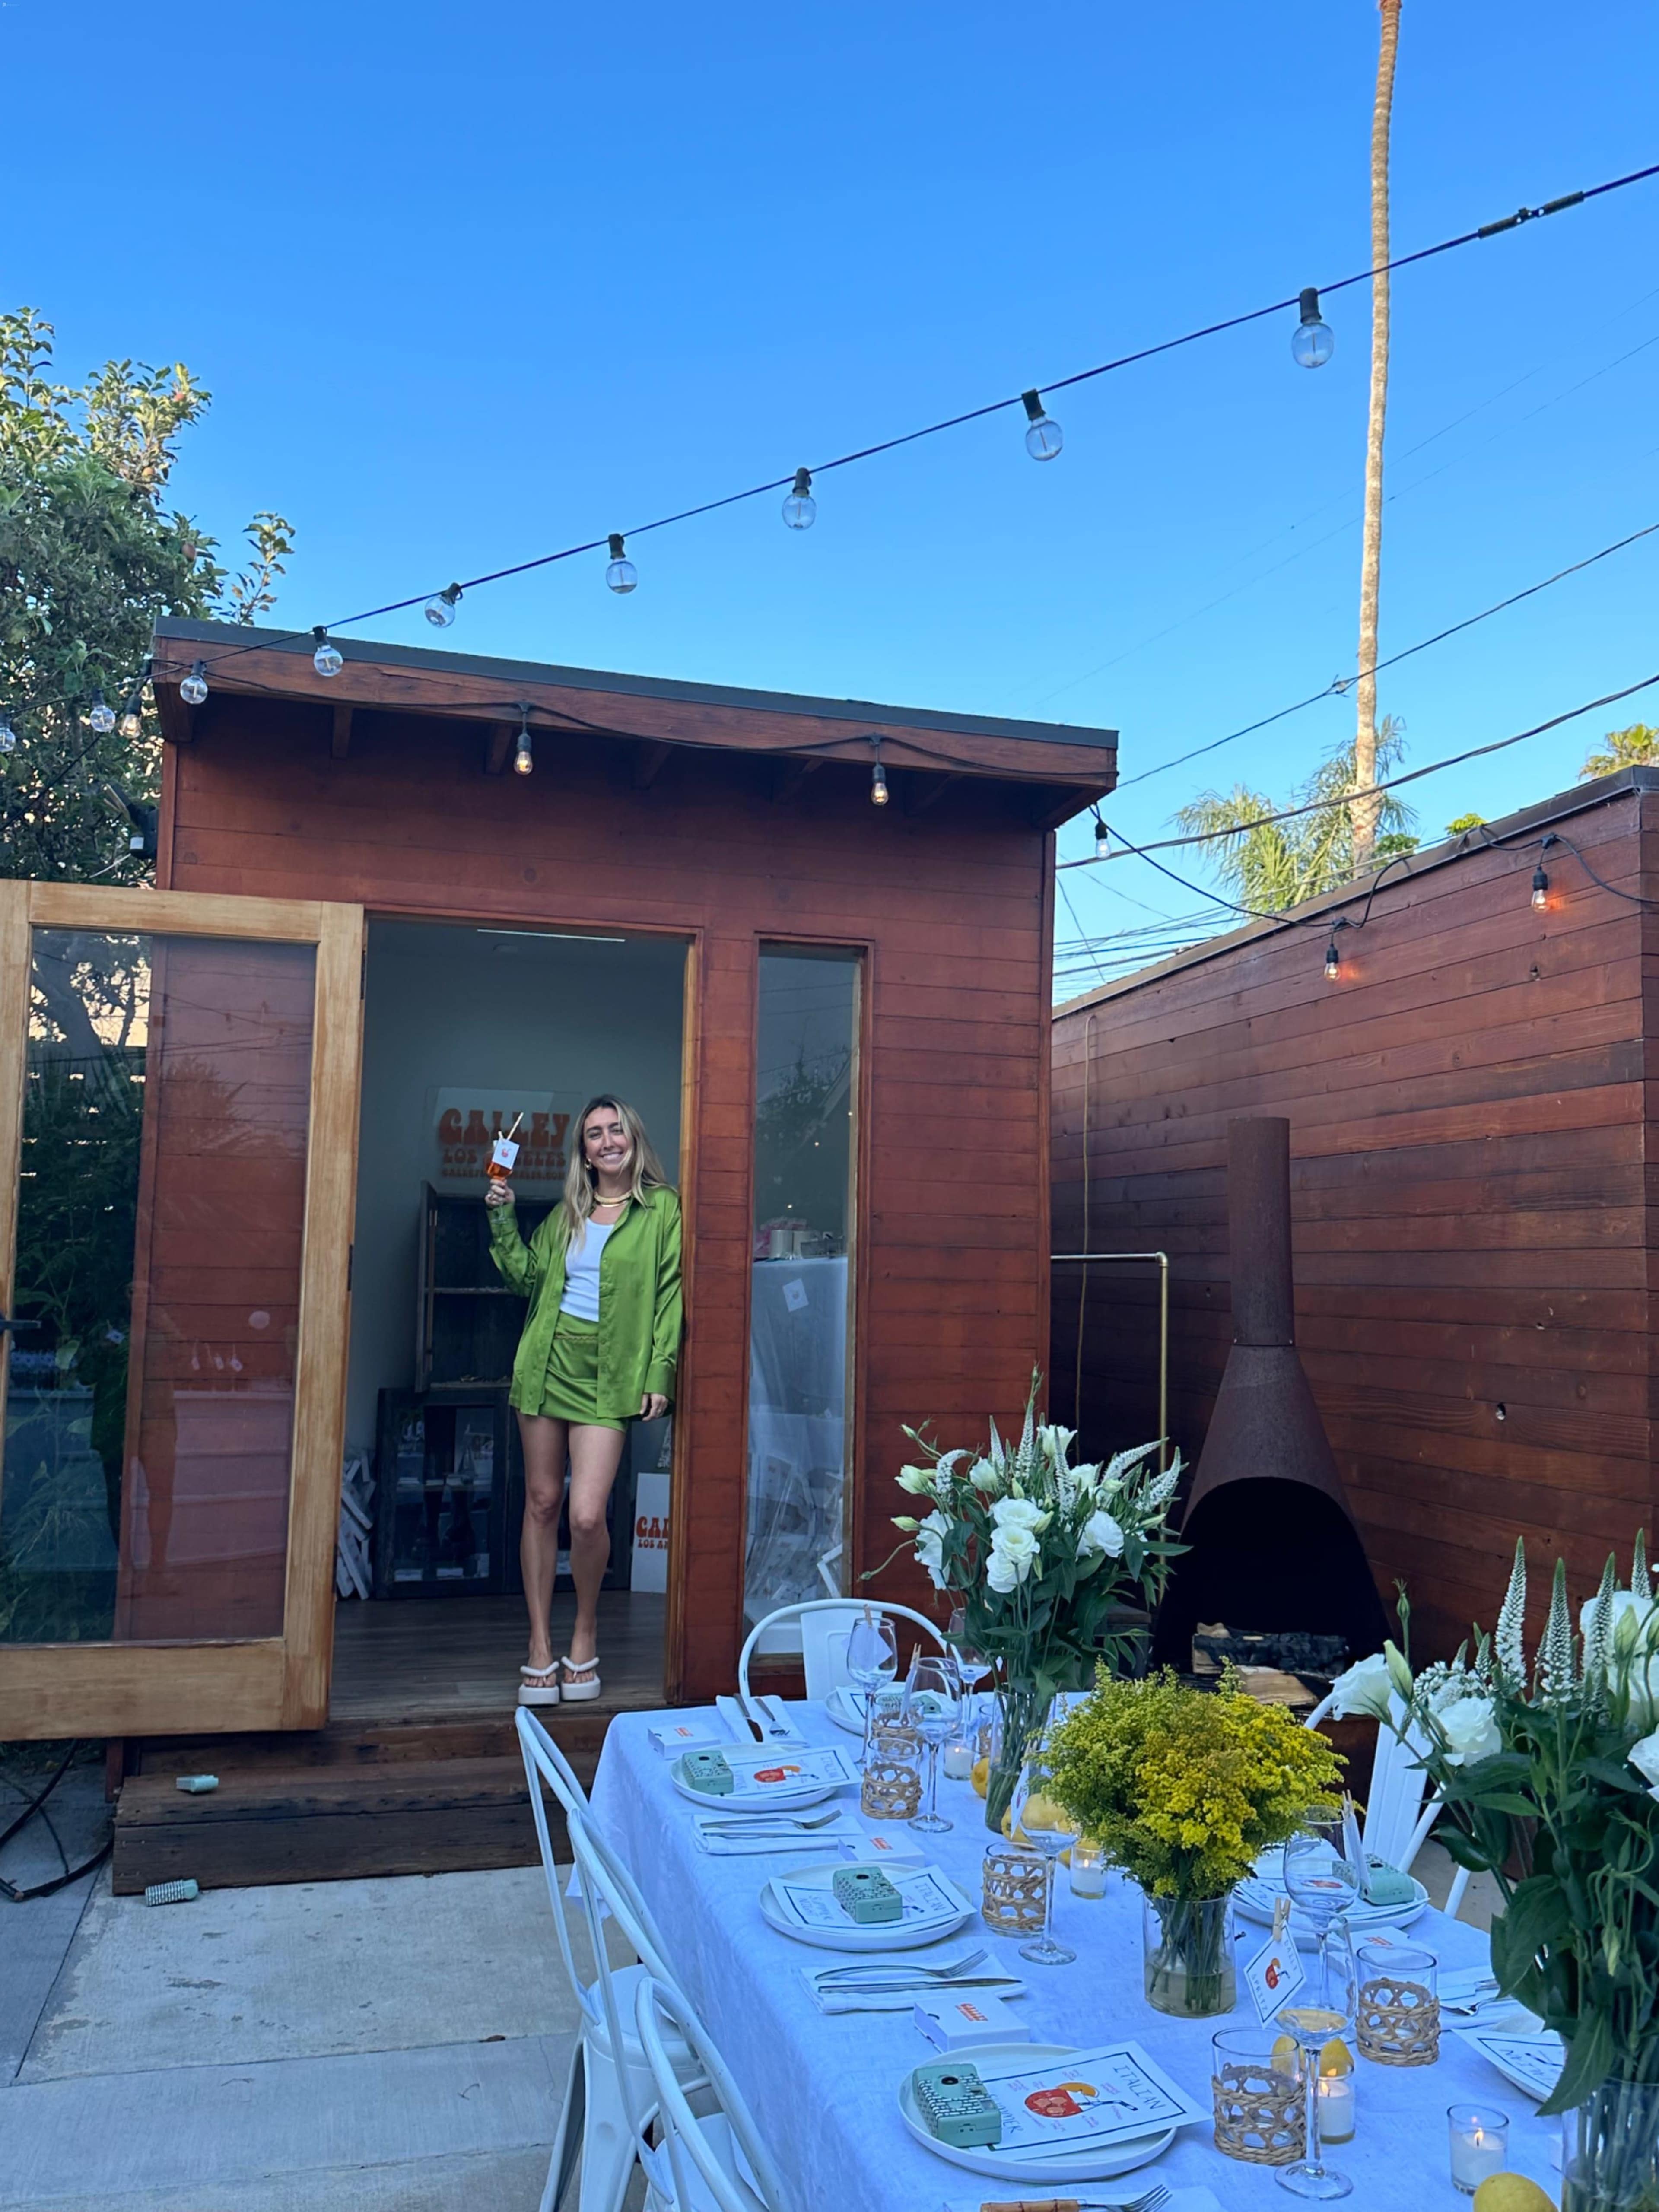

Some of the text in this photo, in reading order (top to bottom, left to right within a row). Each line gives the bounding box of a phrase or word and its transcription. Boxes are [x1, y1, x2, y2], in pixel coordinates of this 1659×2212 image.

[442, 1148, 477, 1163] LOS
[638, 1539, 655, 1549] LOS
[1112, 2065, 1166, 2110] ITALIAN
